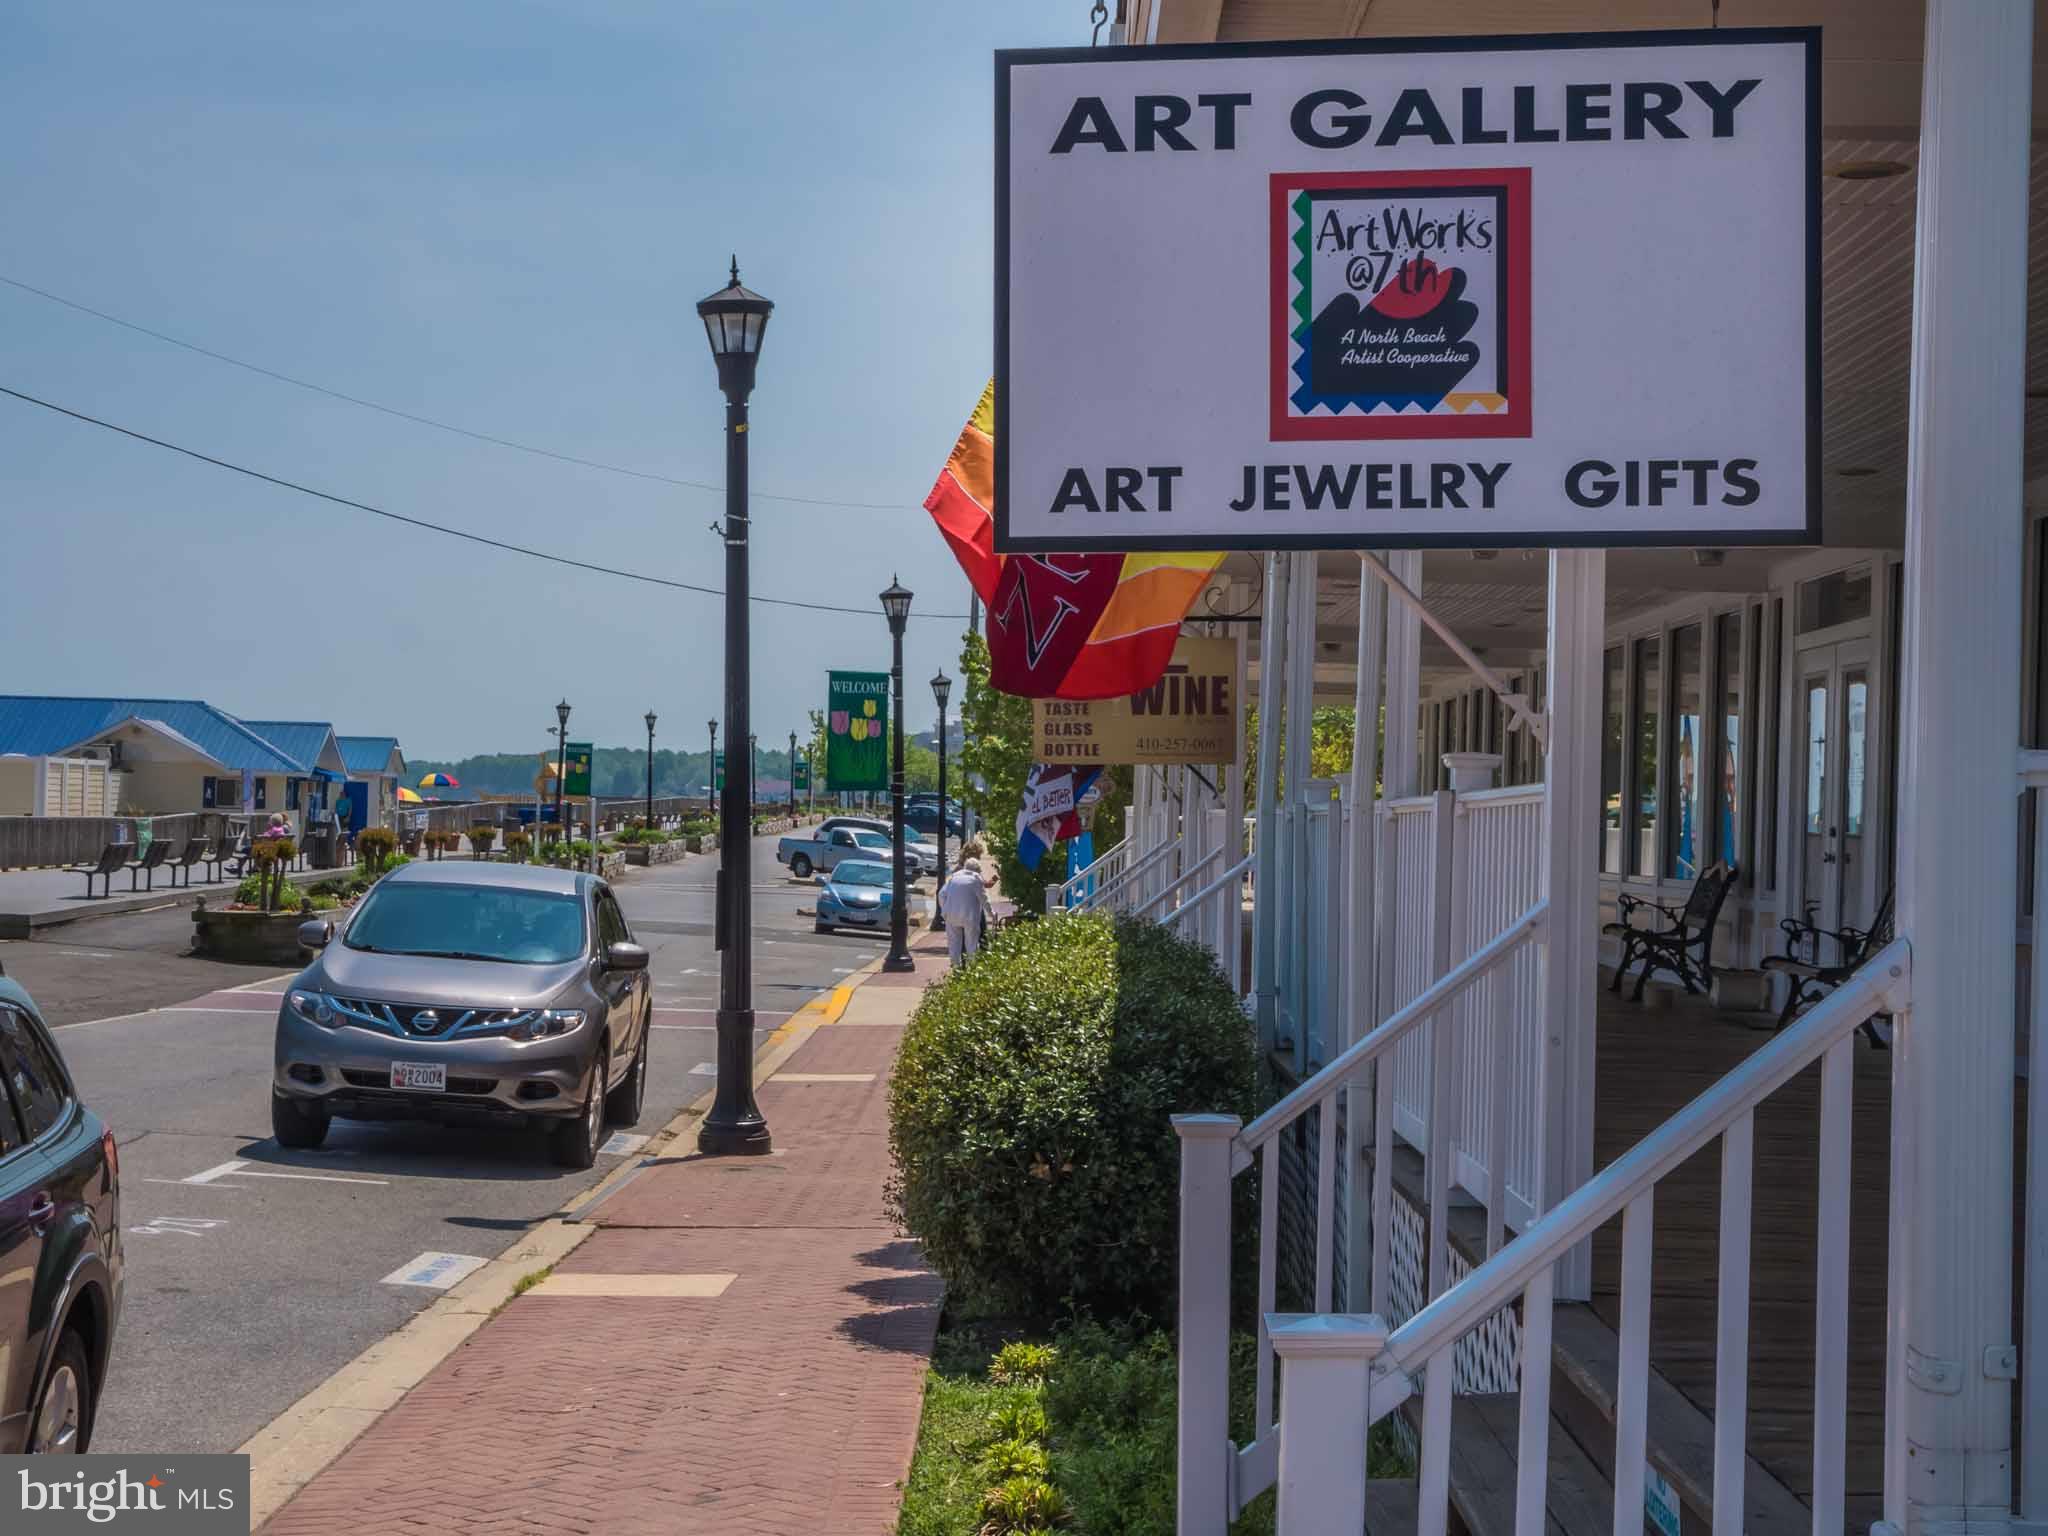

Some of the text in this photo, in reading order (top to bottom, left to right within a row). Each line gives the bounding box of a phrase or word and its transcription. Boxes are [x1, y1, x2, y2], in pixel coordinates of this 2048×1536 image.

[1049, 79, 1762, 153] ART GALLERY
[1341, 326, 1446, 344] A North Beach
[1341, 347, 1470, 368] Artist Cooperative
[1050, 459, 1760, 512] ART JEWELRY GIFTS
[832, 680, 887, 694] WELCOME
[1130, 675, 1230, 716] WINE
[1044, 702, 1089, 716] TASTE
[1044, 722, 1093, 736] GLASS
[1043, 743, 1100, 757] BOTTLE
